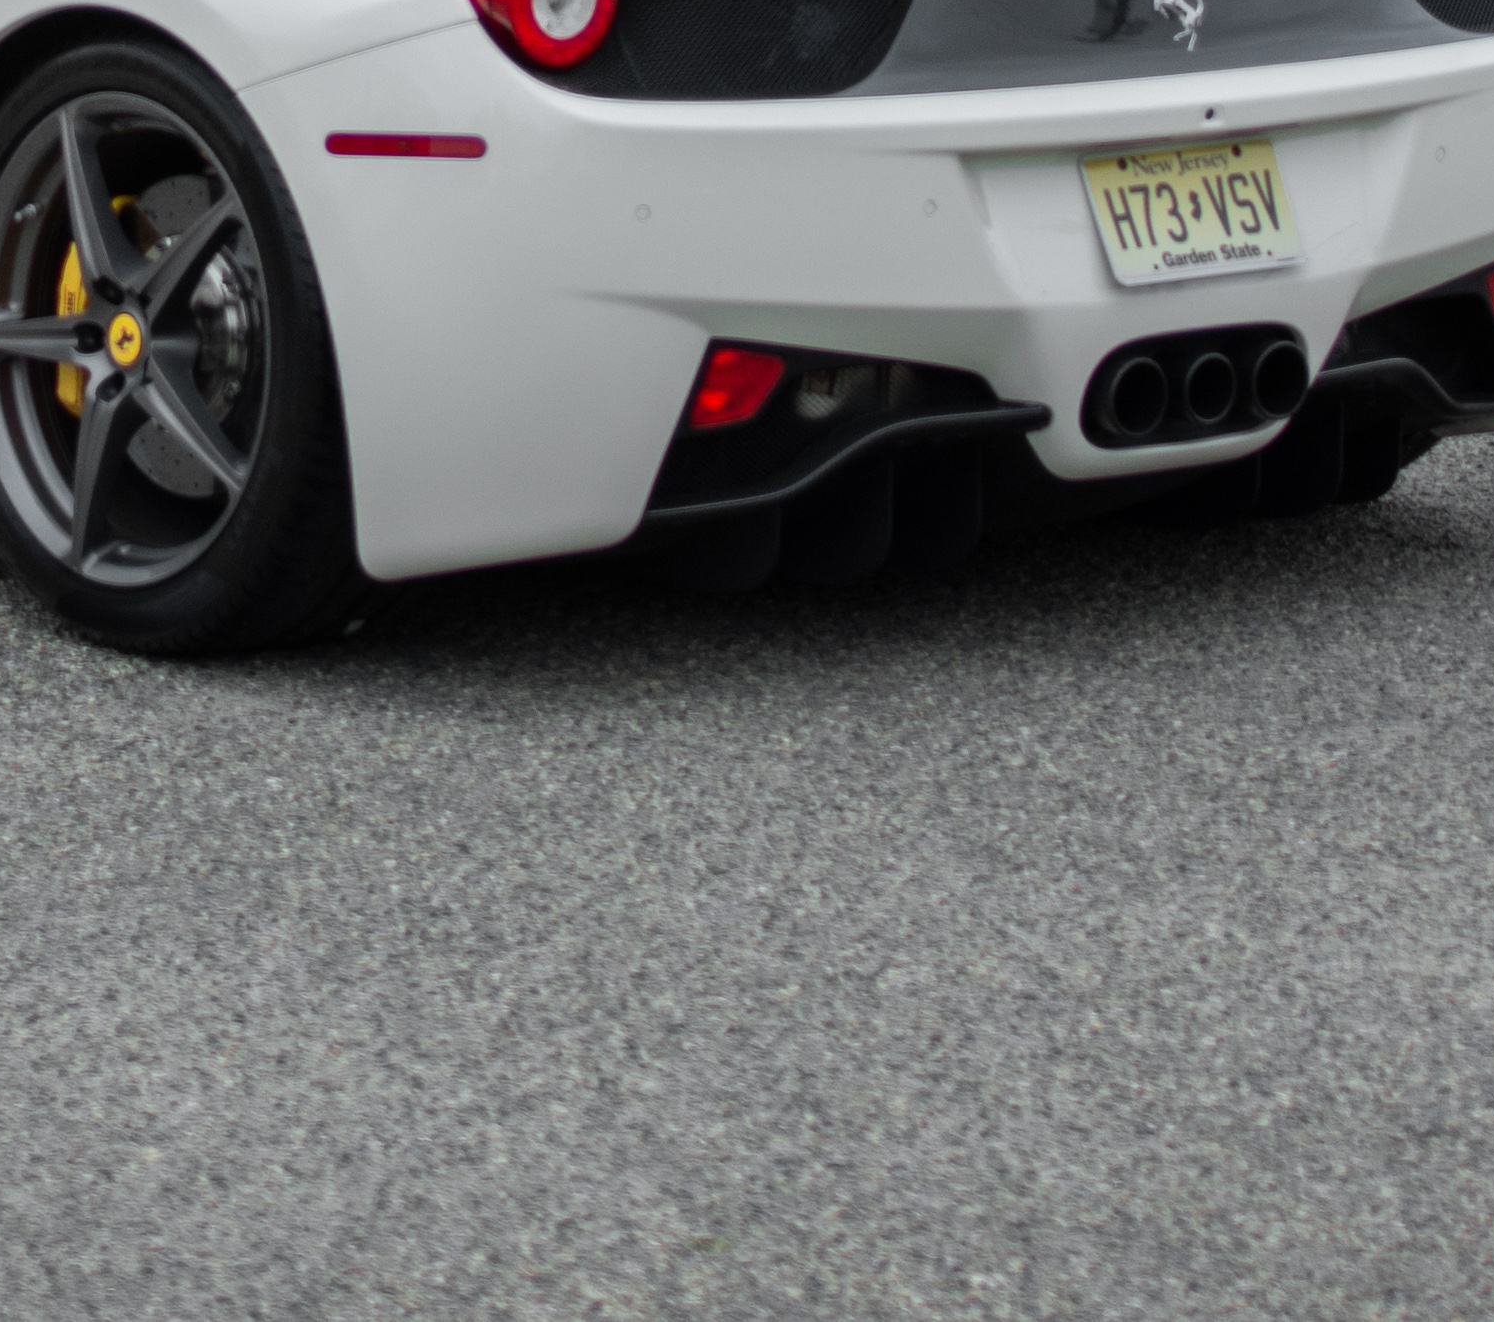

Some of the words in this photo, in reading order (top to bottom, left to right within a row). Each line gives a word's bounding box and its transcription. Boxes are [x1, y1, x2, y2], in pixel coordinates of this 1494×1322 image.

[1129, 154, 1173, 177] New
[1175, 150, 1229, 176] Jersey
[1162, 247, 1217, 268] Garden
[1220, 242, 1261, 261] State
